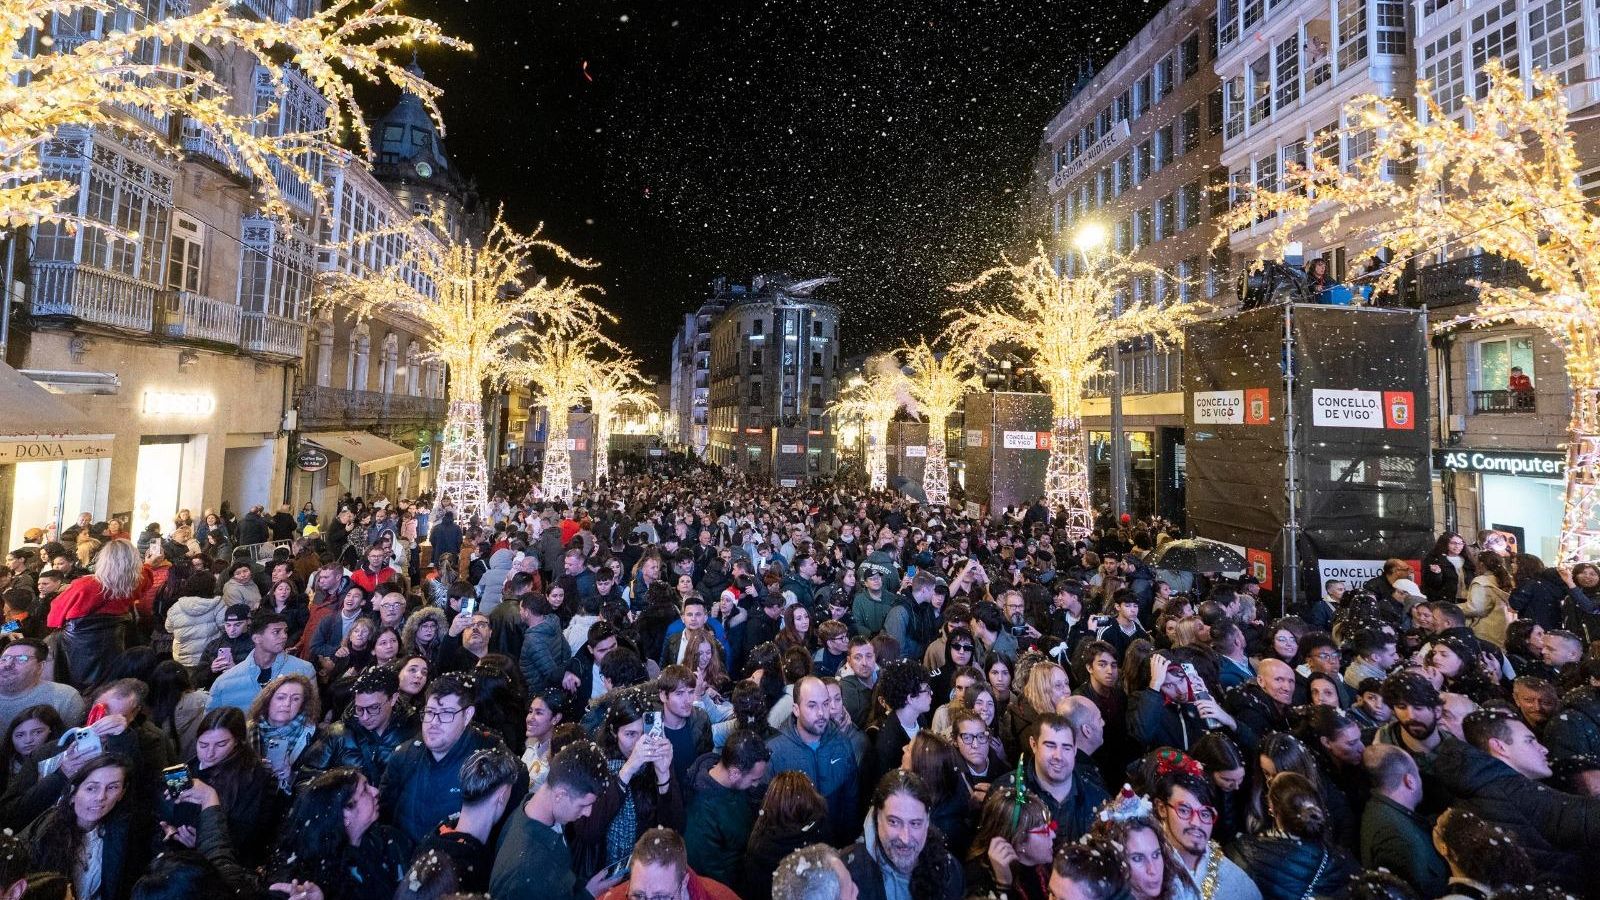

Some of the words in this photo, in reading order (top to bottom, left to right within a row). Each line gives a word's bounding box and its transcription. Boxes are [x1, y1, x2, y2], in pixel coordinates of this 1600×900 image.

[1196, 397, 1240, 407] CONCELLO
[1317, 396, 1376, 409] CONCELLO
[1201, 408, 1211, 417] DE
[1213, 407, 1234, 417] VIGO
[1325, 409, 1340, 419] DE
[1342, 410, 1370, 420] VIGO
[15, 443, 65, 458] DONA
[1445, 453, 1469, 469] AS
[1471, 453, 1565, 474] Computer
[1323, 567, 1385, 578] CONCELLO
[1350, 580, 1369, 590] VIG
